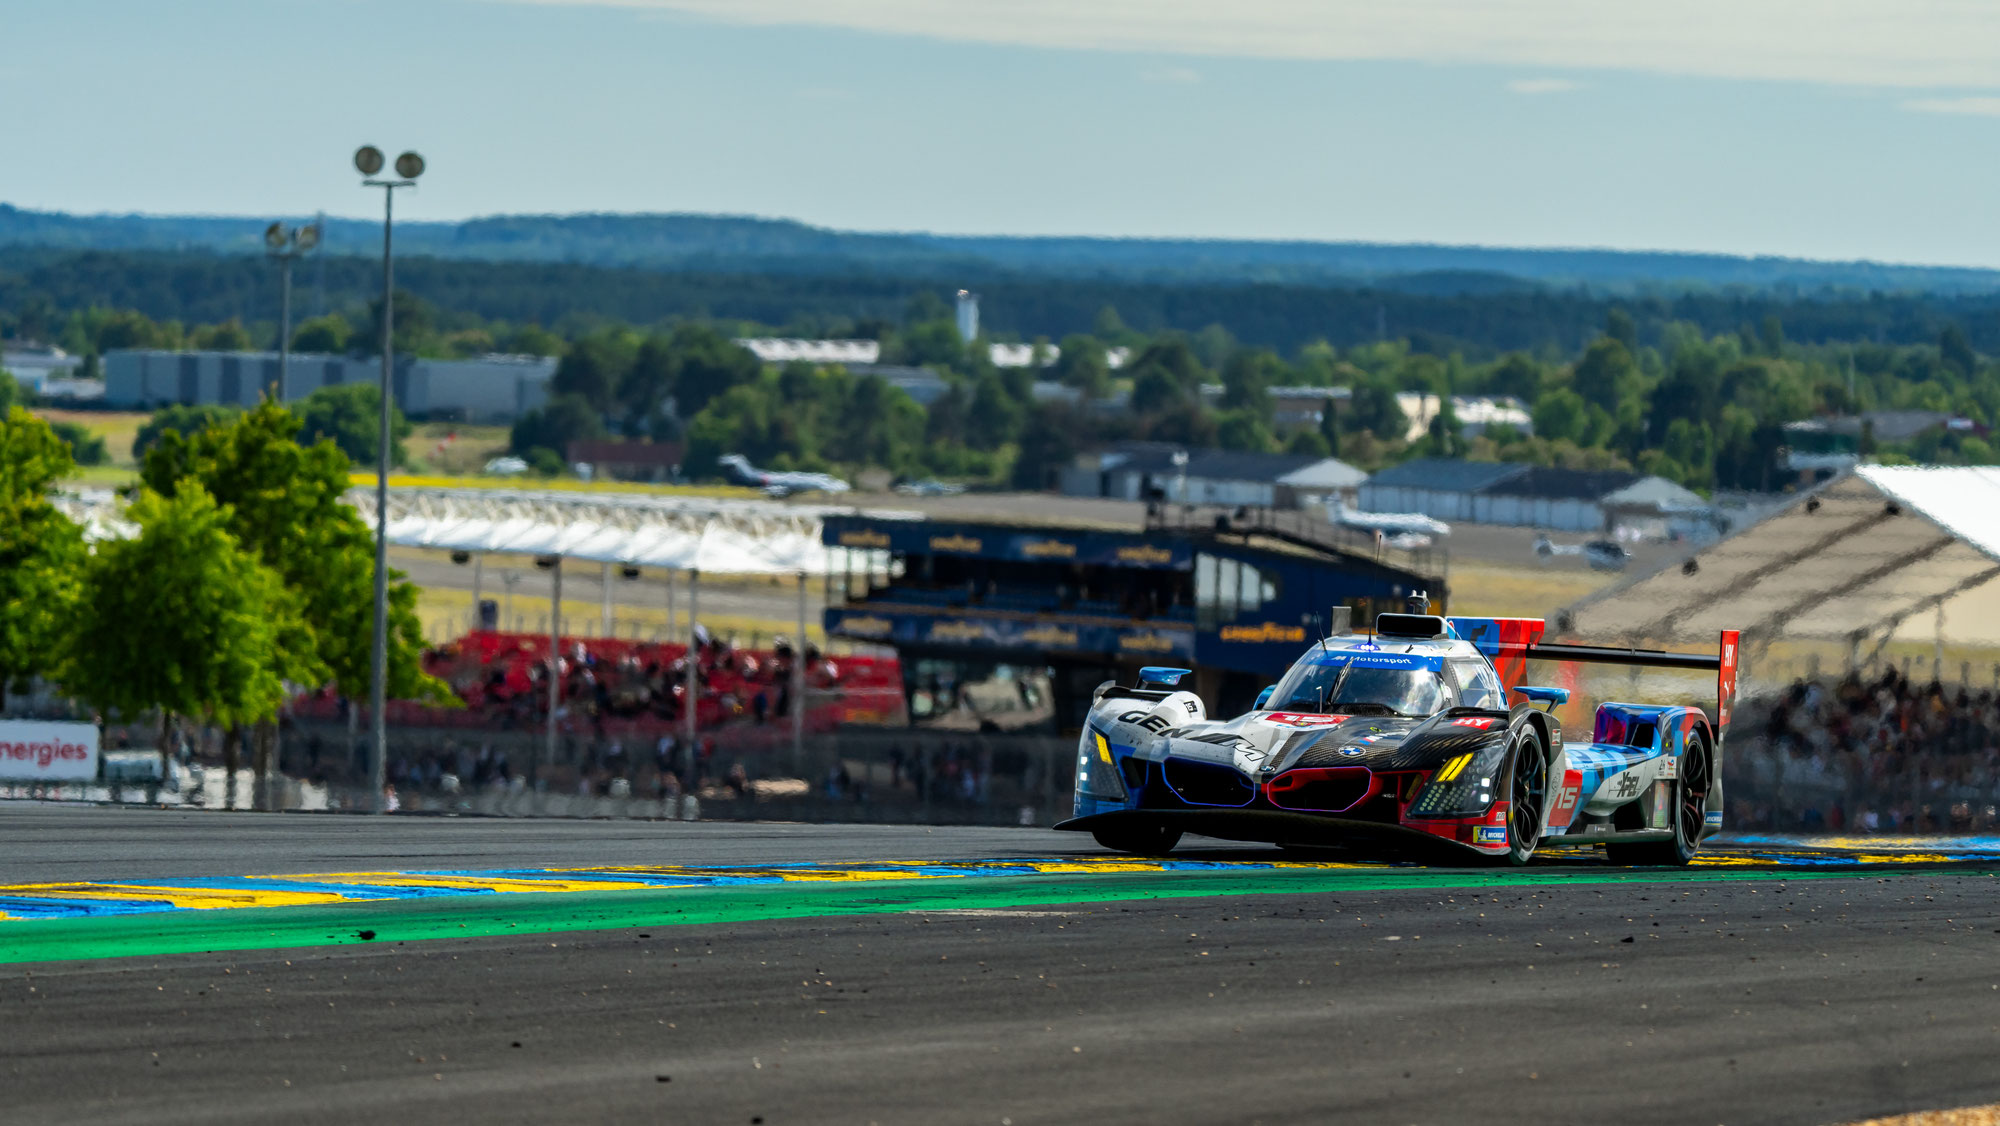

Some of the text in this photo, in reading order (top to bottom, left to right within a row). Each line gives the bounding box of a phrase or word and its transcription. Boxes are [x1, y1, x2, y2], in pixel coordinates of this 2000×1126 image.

[1350, 656, 1411, 664] Motorsport
[1617, 772, 1640, 797] XPEL
[1557, 787, 1577, 808] 15
